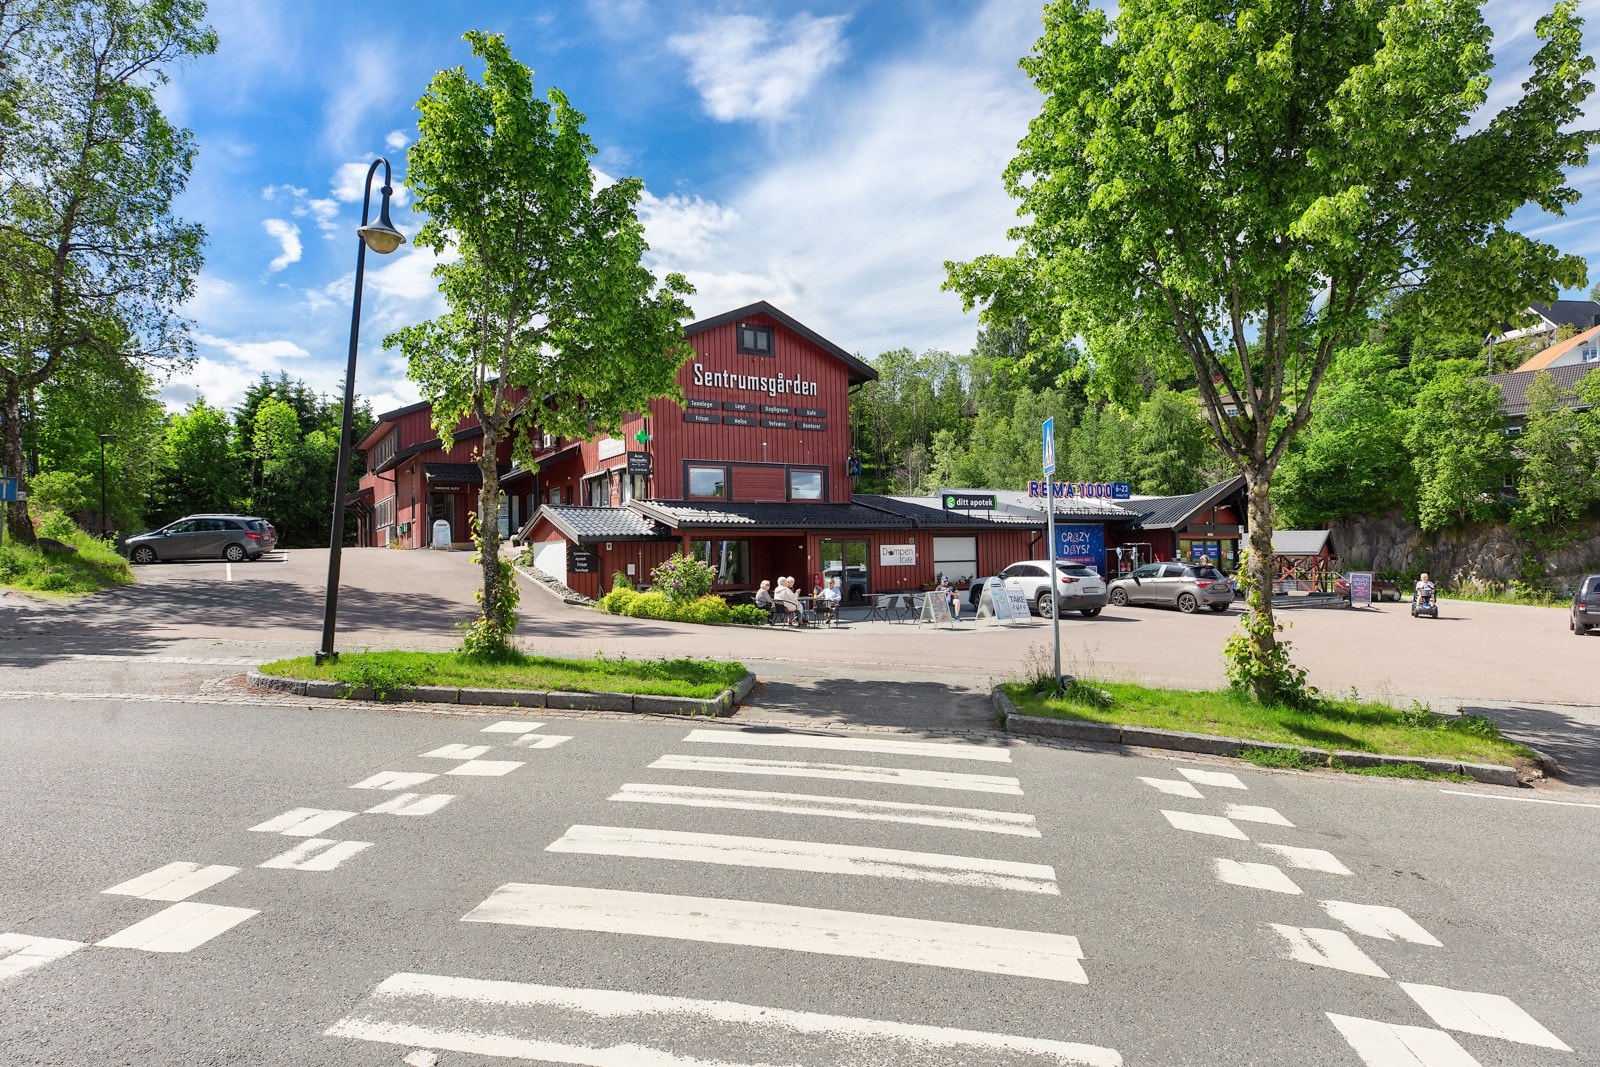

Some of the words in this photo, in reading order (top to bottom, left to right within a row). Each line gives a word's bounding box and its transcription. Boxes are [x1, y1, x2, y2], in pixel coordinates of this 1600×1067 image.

[694, 363, 817, 397] Sentrumsgården
[691, 400, 713, 408] Tannlege
[1028, 481, 1075, 498] REMA
[1079, 482, 1112, 498] 1000
[1115, 484, 1129, 493] 6-23
[956, 498, 969, 506] ditt
[970, 498, 993, 508] apotek
